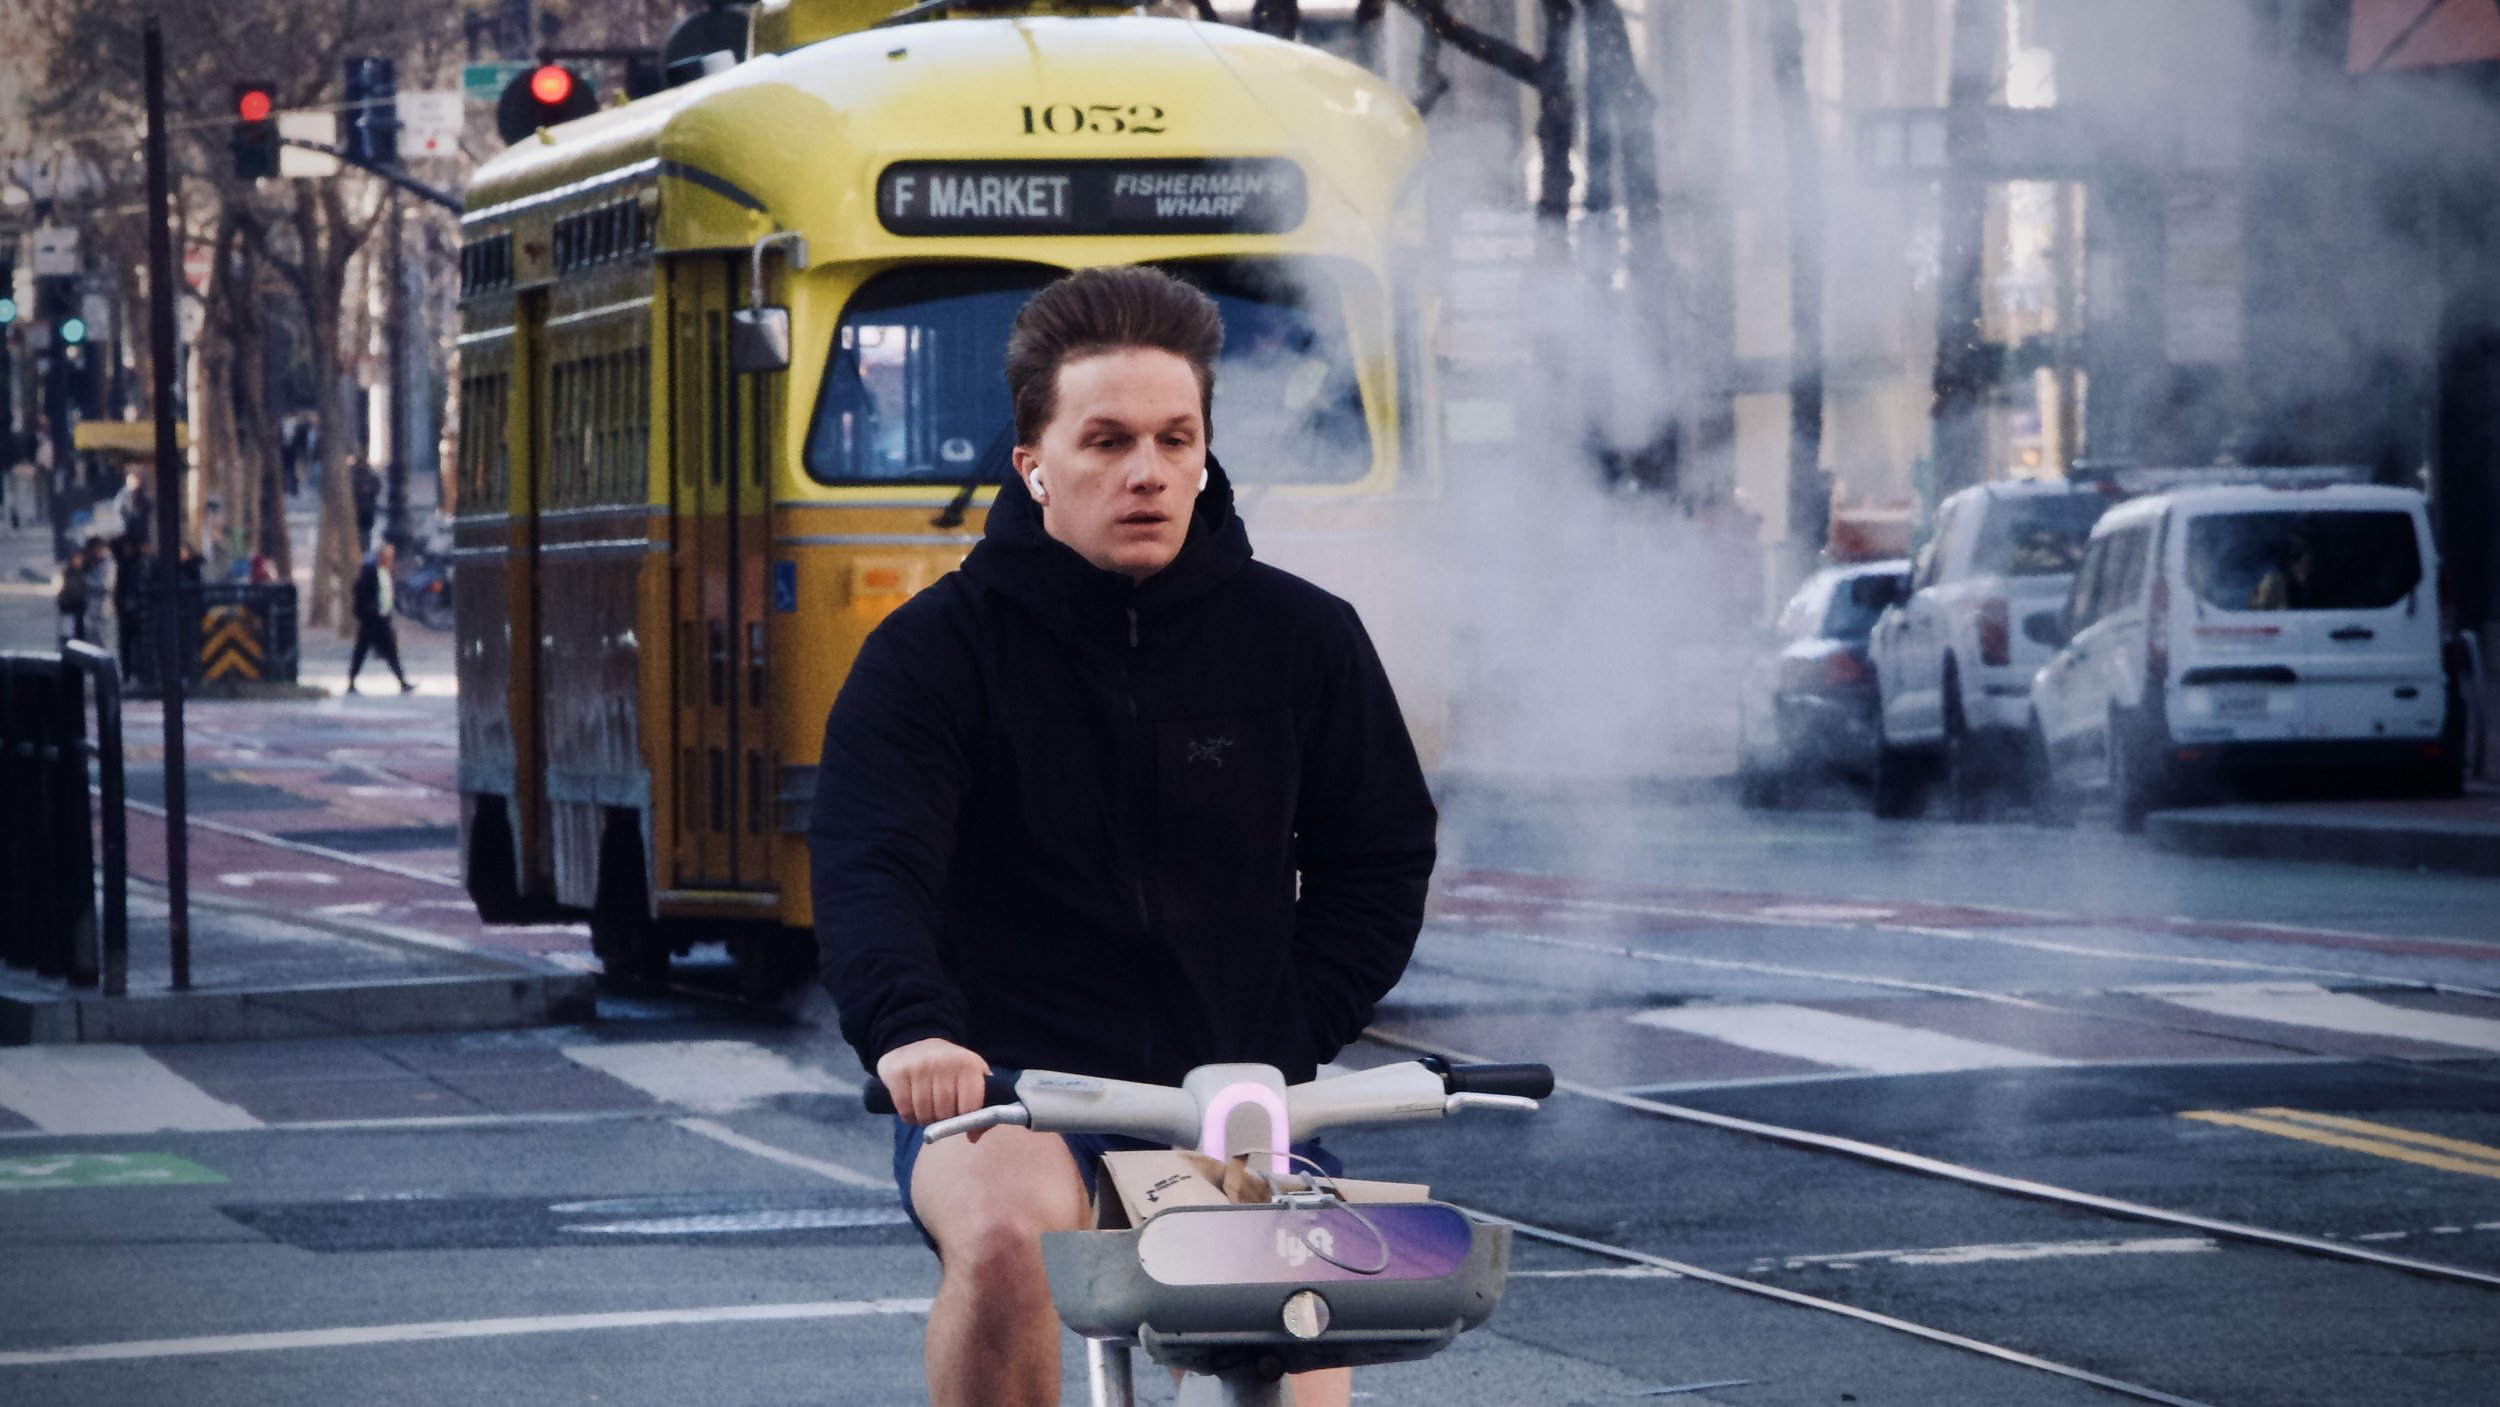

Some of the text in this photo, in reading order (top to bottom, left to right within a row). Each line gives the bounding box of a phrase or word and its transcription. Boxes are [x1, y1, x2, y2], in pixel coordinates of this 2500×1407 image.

[1018, 104, 1167, 135] 1052
[895, 176, 1069, 217] F MARKET
[1156, 196, 1246, 217] WHARF
